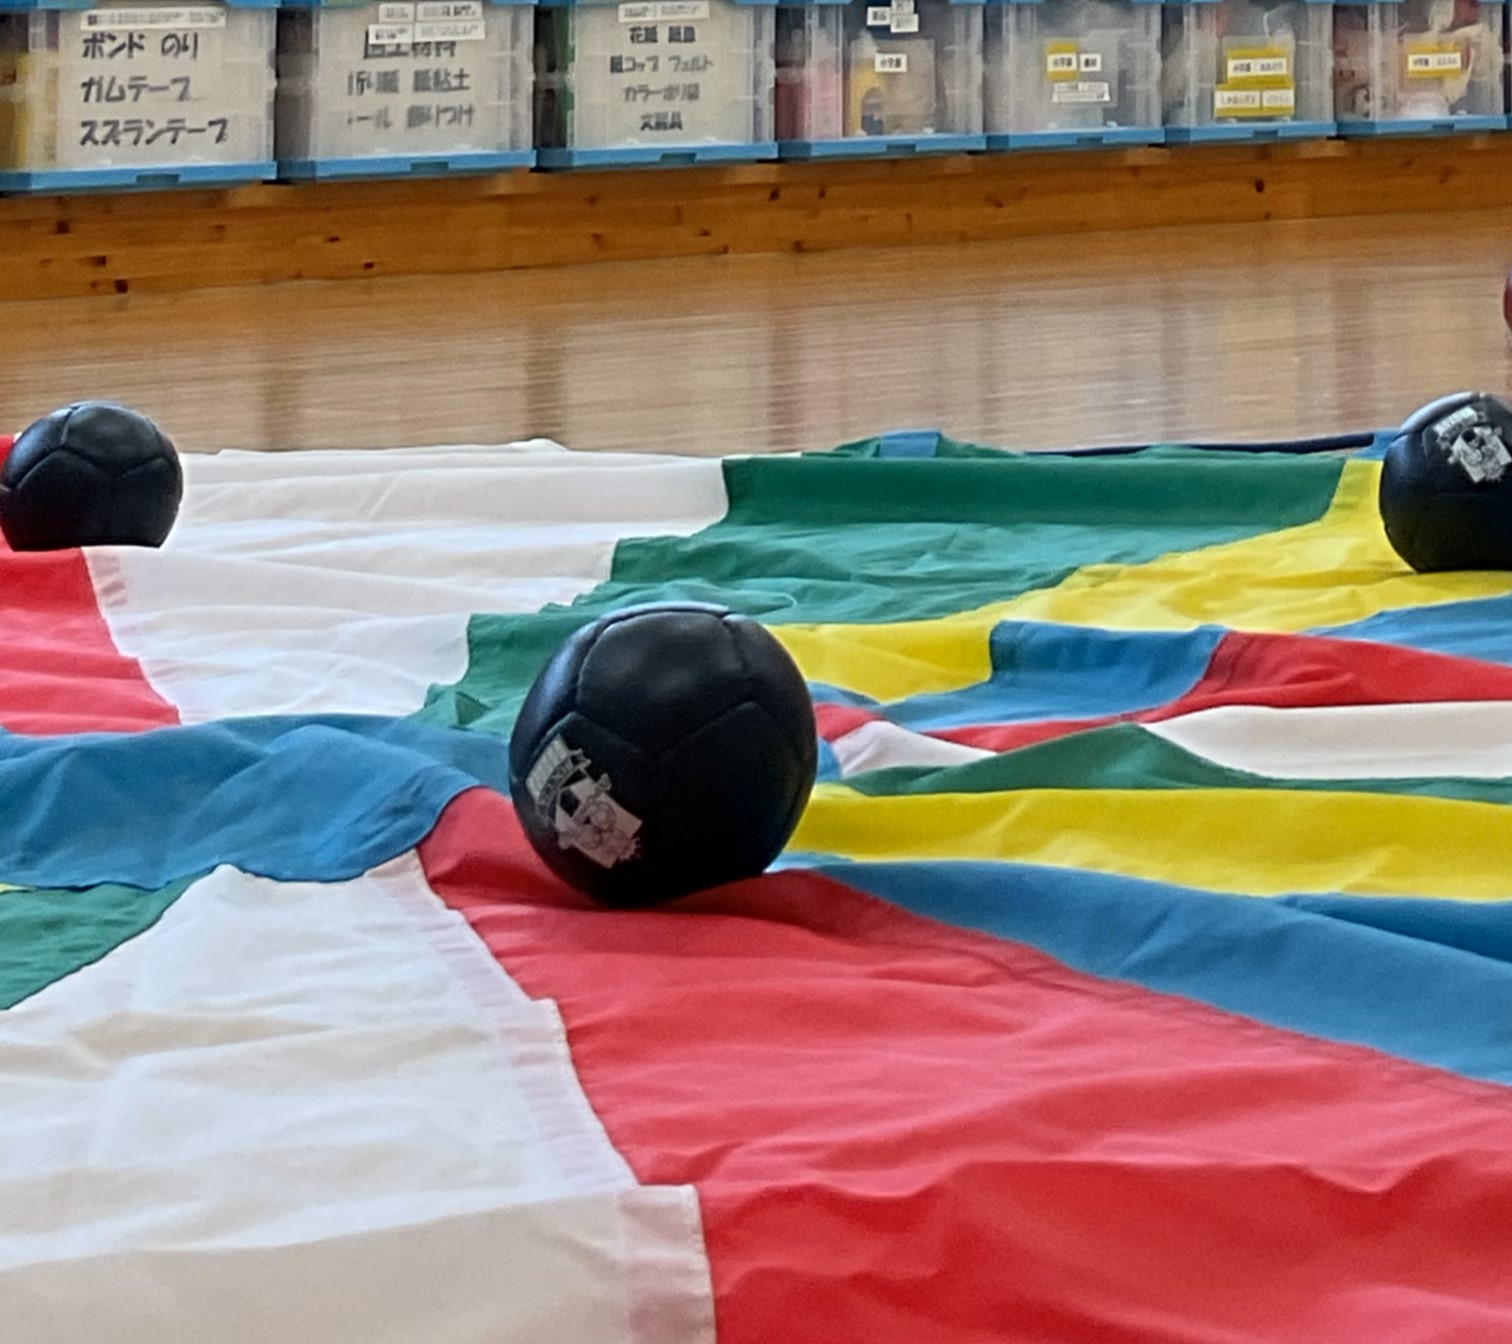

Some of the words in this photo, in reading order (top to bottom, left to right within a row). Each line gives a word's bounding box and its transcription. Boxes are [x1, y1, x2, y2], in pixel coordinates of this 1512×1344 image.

[82, 32, 145, 59] ボンド
[160, 32, 199, 60] のり
